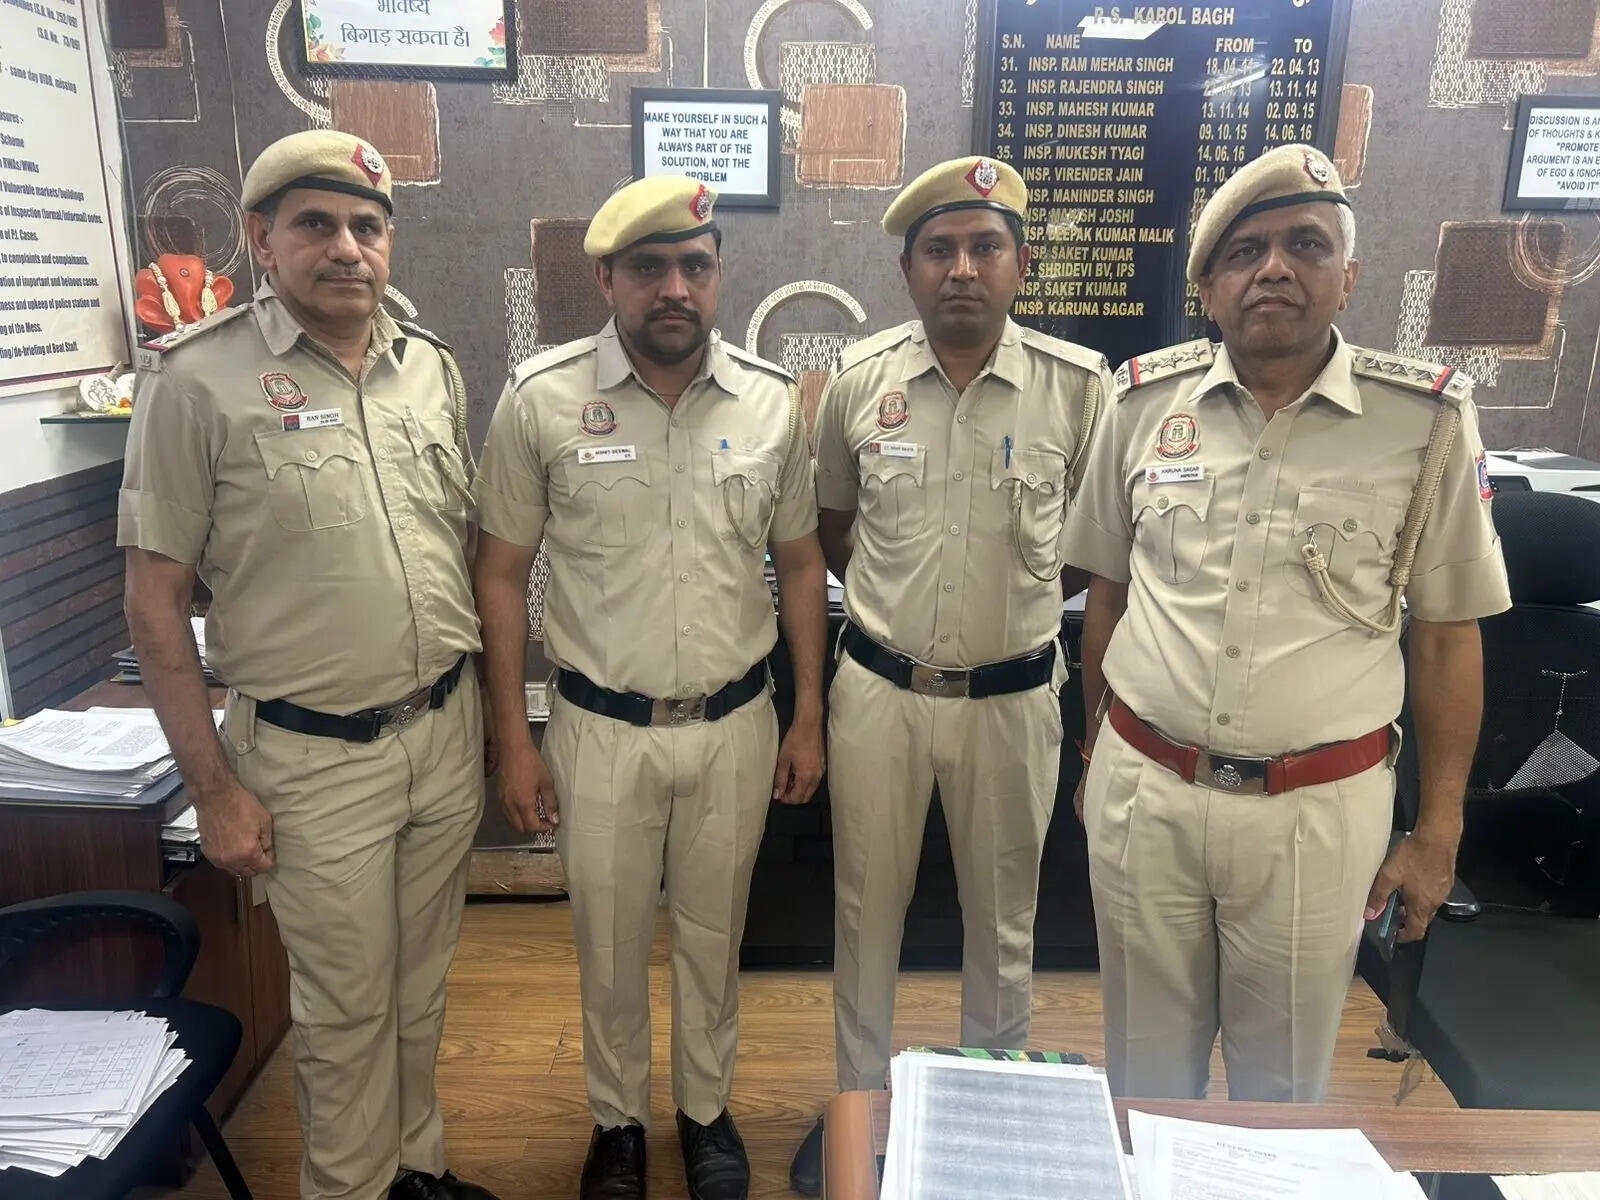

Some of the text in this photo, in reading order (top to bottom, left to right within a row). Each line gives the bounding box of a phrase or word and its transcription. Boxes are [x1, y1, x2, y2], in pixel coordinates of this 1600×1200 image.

[1133, 7, 1186, 25] KAROL
[1191, 7, 1235, 25] BAGH
[341, 23, 391, 47] बिगाड़
[395, 30, 449, 45] सकता
[1002, 34, 1313, 53] S.N. NAME FROM TO
[1001, 57, 1018, 71] 31.
[1028, 57, 1057, 71] INSP.
[1061, 57, 1087, 71] RAM
[1090, 57, 1133, 72] MEHAR
[1136, 57, 1174, 72] SINGH
[999, 79, 1017, 94] 32.
[1027, 79, 1056, 94] INSP.
[1059, 79, 1122, 94] RAJENDRA
[1126, 80, 1164, 95] SINGH
[998, 101, 1016, 116] 33.
[1026, 101, 1054, 116] INSP.
[1058, 102, 1108, 116] MAHESH
[1111, 102, 1155, 117] KUMAR
[644, 112, 768, 125] MAKE YOURSELF IN SUCH A
[1529, 115, 1590, 125] DISCUSSION IS
[662, 127, 748, 139] WAY THAT YOU ARE
[997, 123, 1015, 137] 34.
[1024, 123, 1053, 138] INSP.
[1056, 124, 1101, 138] DINESH
[1104, 124, 1147, 139] KUMAR
[1528, 129, 1539, 138] OF
[1542, 129, 1585, 138] THOUGHTS
[1587, 129, 1593, 138] &
[658, 142, 752, 154] ALWAYS PART OF THE
[996, 145, 1013, 159] 35.
[1023, 145, 1052, 160] INSP.
[1055, 145, 1106, 160] MUKESH
[1110, 146, 1145, 160] TYAGI
[661, 156, 750, 169] SOLUTION, NOT THE
[1526, 155, 1571, 164] ARGUMENT
[1572, 156, 1580, 164] IS
[1582, 156, 1593, 165] AN
[1022, 167, 1050, 181] INSP.
[1054, 167, 1113, 181] VIRENDER
[1115, 168, 1144, 182] JAIN
[1537, 168, 1548, 177] OF
[1550, 168, 1567, 177] EGO
[1568, 168, 1574, 177] &
[1026, 188, 1155, 203] NSP. MANINDER SINGH
[1023, 208, 1047, 222] NSP.
[1099, 208, 1135, 223] JOSHI
[1022, 226, 1045, 241] NSP.
[1048, 226, 1092, 241] DEEPAK
[1095, 227, 1136, 242] KUMAR
[1138, 227, 1176, 243] MALIK
[1051, 247, 1133, 261] SAKET KUMAR
[1038, 262, 1135, 280] SHRIDEVI BV, IPS
[1018, 281, 1127, 296] NSP. SAKET KUMAR
[1014, 301, 1044, 315] INSP.
[1047, 301, 1099, 316] KARUNA
[1102, 302, 1144, 316] SAGAR
